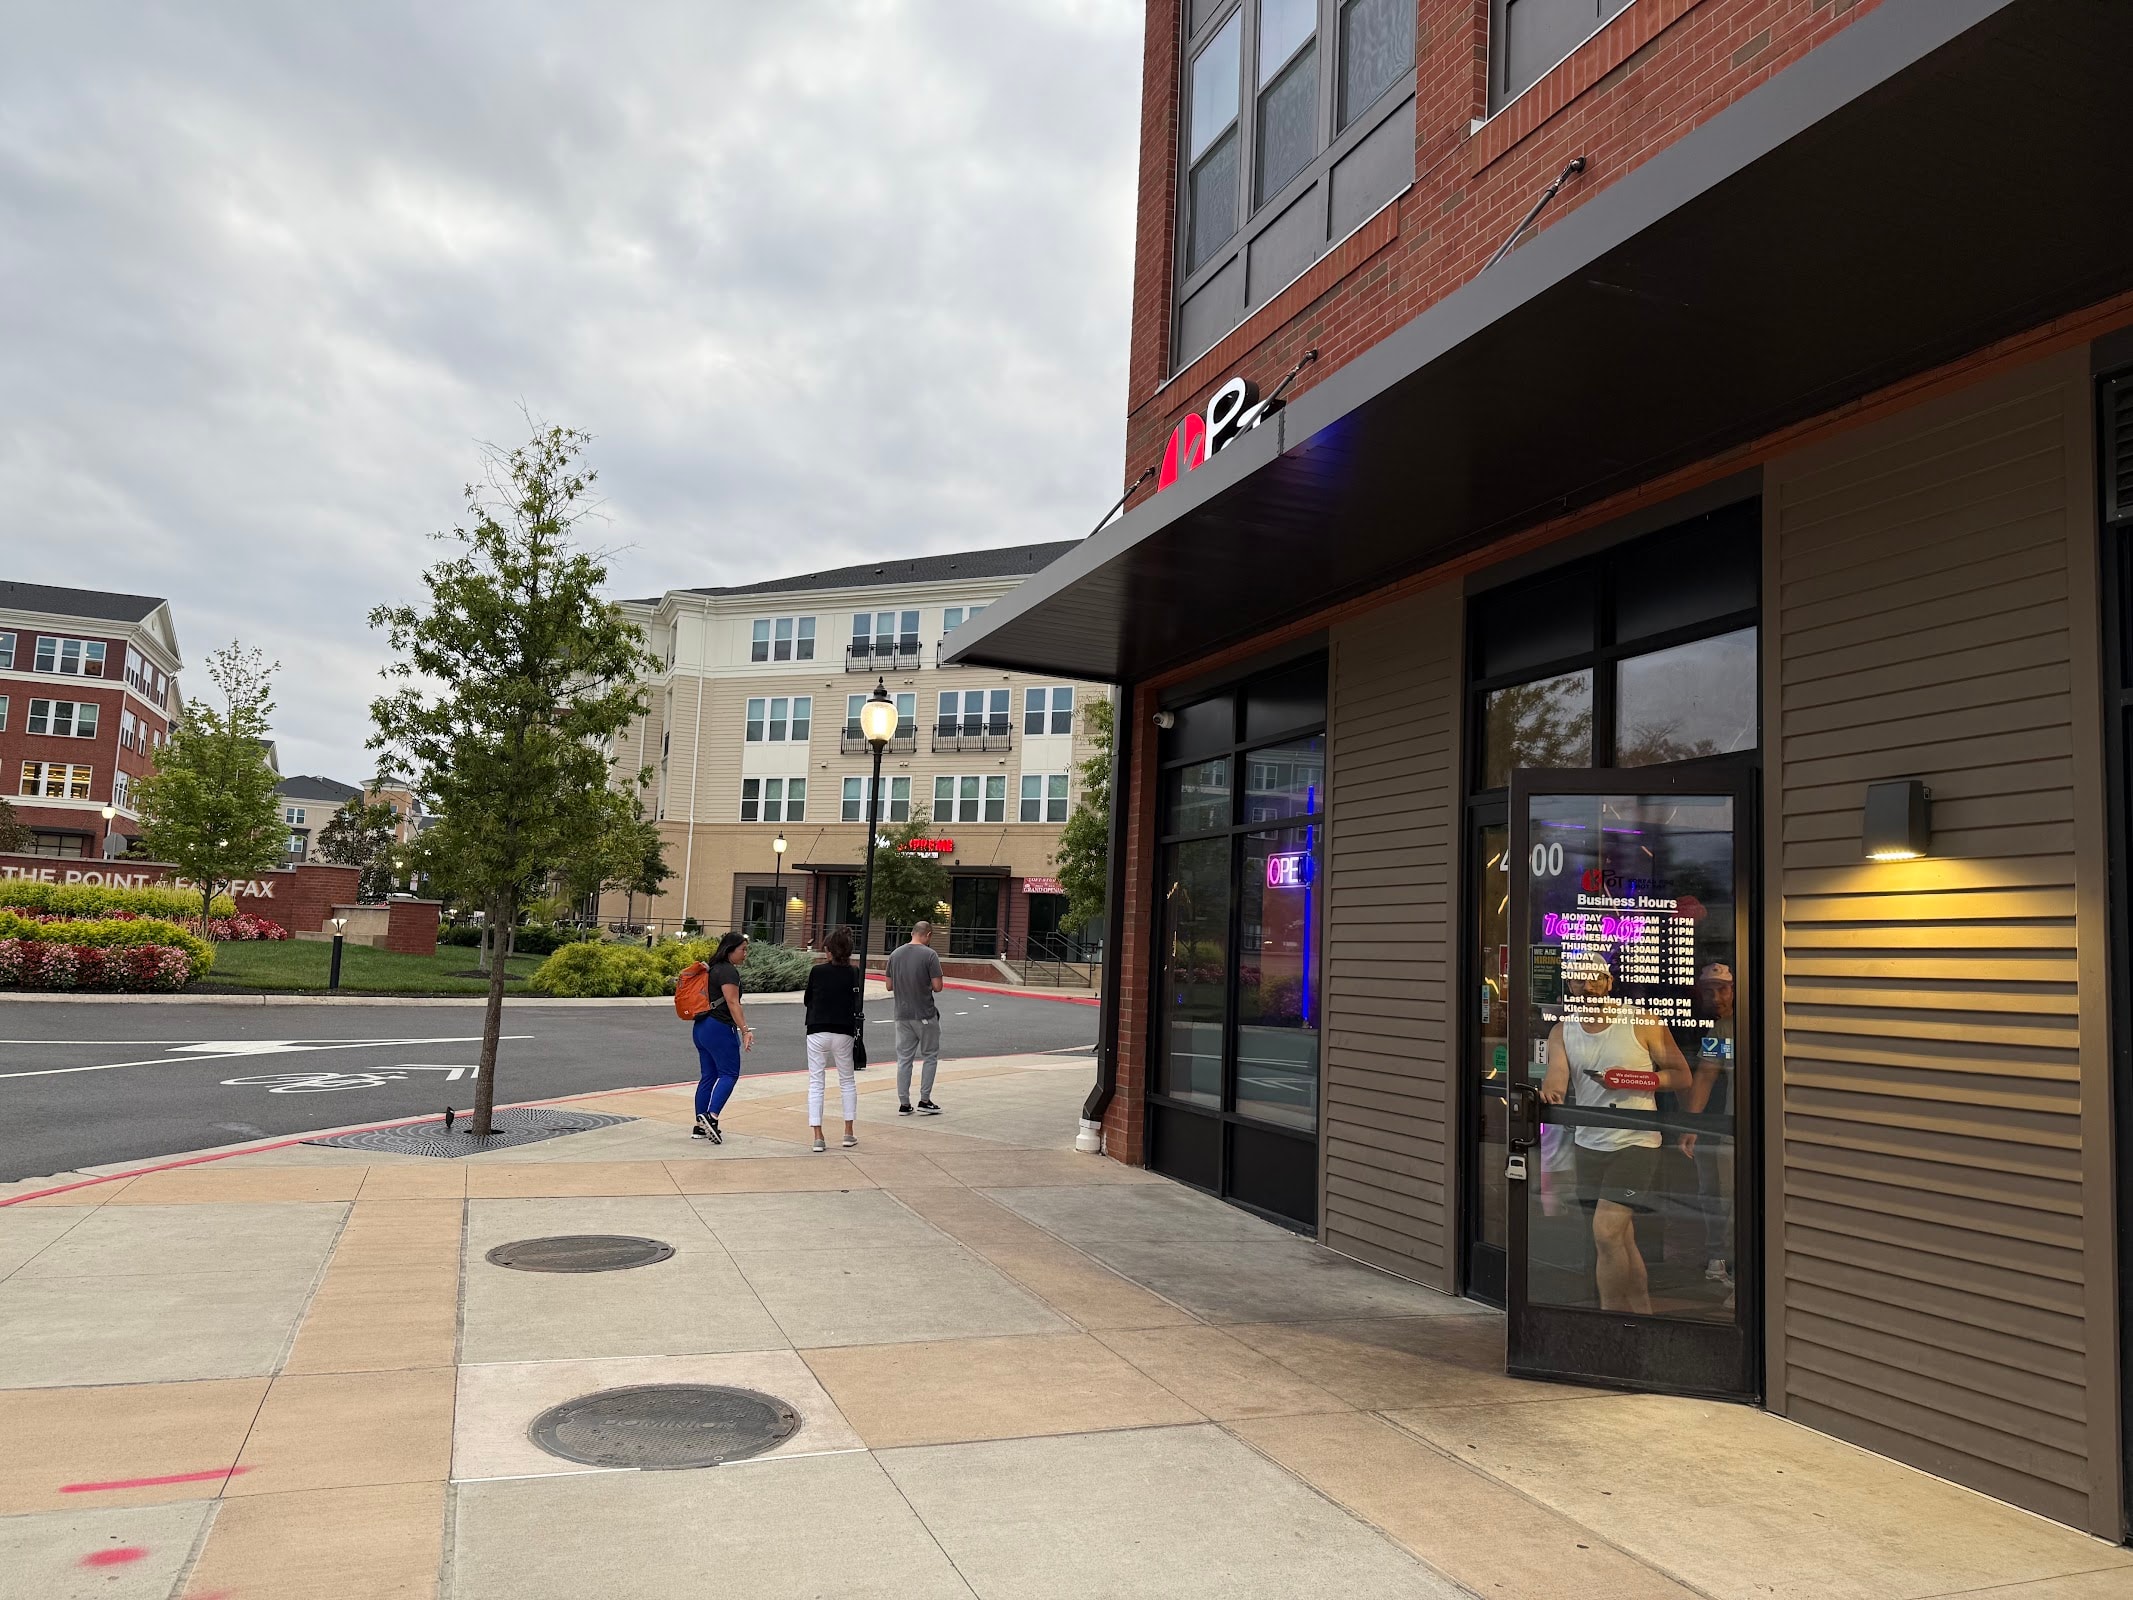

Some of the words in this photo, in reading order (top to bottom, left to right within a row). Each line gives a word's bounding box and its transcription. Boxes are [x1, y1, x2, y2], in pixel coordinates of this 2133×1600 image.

[1270, 856, 1307, 885] OPE
[2, 866, 57, 886] THE
[65, 870, 150, 890] POINT
[155, 880, 169, 889] AT
[1577, 894, 1635, 907] Business
[1638, 896, 1678, 909] Hours
[1561, 913, 1602, 922] MONDAY
[1668, 917, 1694, 926] 11PM
[1561, 923, 1605, 932] TUESDAY
[1668, 927, 1694, 936] 11PM
[1561, 932, 1620, 942] WEDNESDAY
[1668, 937, 1694, 946] 11PM
[1561, 942, 1613, 952] THURSDAY
[1619, 945, 1660, 954] 11:30AM
[1668, 946, 1694, 956] 11PM
[1534, 955, 1561, 965] HIRING
[1561, 952, 1595, 961] FRIDAY
[1619, 954, 1660, 964] 11:30AM
[1668, 956, 1694, 966] 11PM
[1561, 962, 1612, 972] SATURDAY
[1619, 964, 1660, 974] 11:30AM
[1668, 966, 1694, 976] 11PM
[1561, 972, 1600, 981] SUNDAY
[1619, 974, 1660, 984] 11:30AM
[1668, 976, 1694, 986] 11PM
[1563, 994, 1585, 1003] Last
[1587, 995, 1622, 1006] seating
[1624, 996, 1633, 1005] is
[1635, 997, 1645, 1006] at
[1648, 997, 1674, 1007] 10:00
[1676, 998, 1692, 1007] PM
[1563, 1004, 1600, 1014] Kitchen
[1602, 1006, 1633, 1015] closes
[1635, 1007, 1646, 1016] at
[1648, 1007, 1675, 1017] 10:30
[1676, 1008, 1692, 1017] PM
[1543, 1013, 1557, 1022] We
[1559, 1014, 1595, 1023] enforce
[1597, 1016, 1604, 1024] a
[1605, 1015, 1628, 1025] hard
[1630, 1016, 1656, 1026] close
[1658, 1018, 1669, 1027] at
[1671, 1018, 1697, 1028] 11:00
[1699, 1019, 1715, 1029] PM
[1620, 1078, 1656, 1086] DOORDASH
